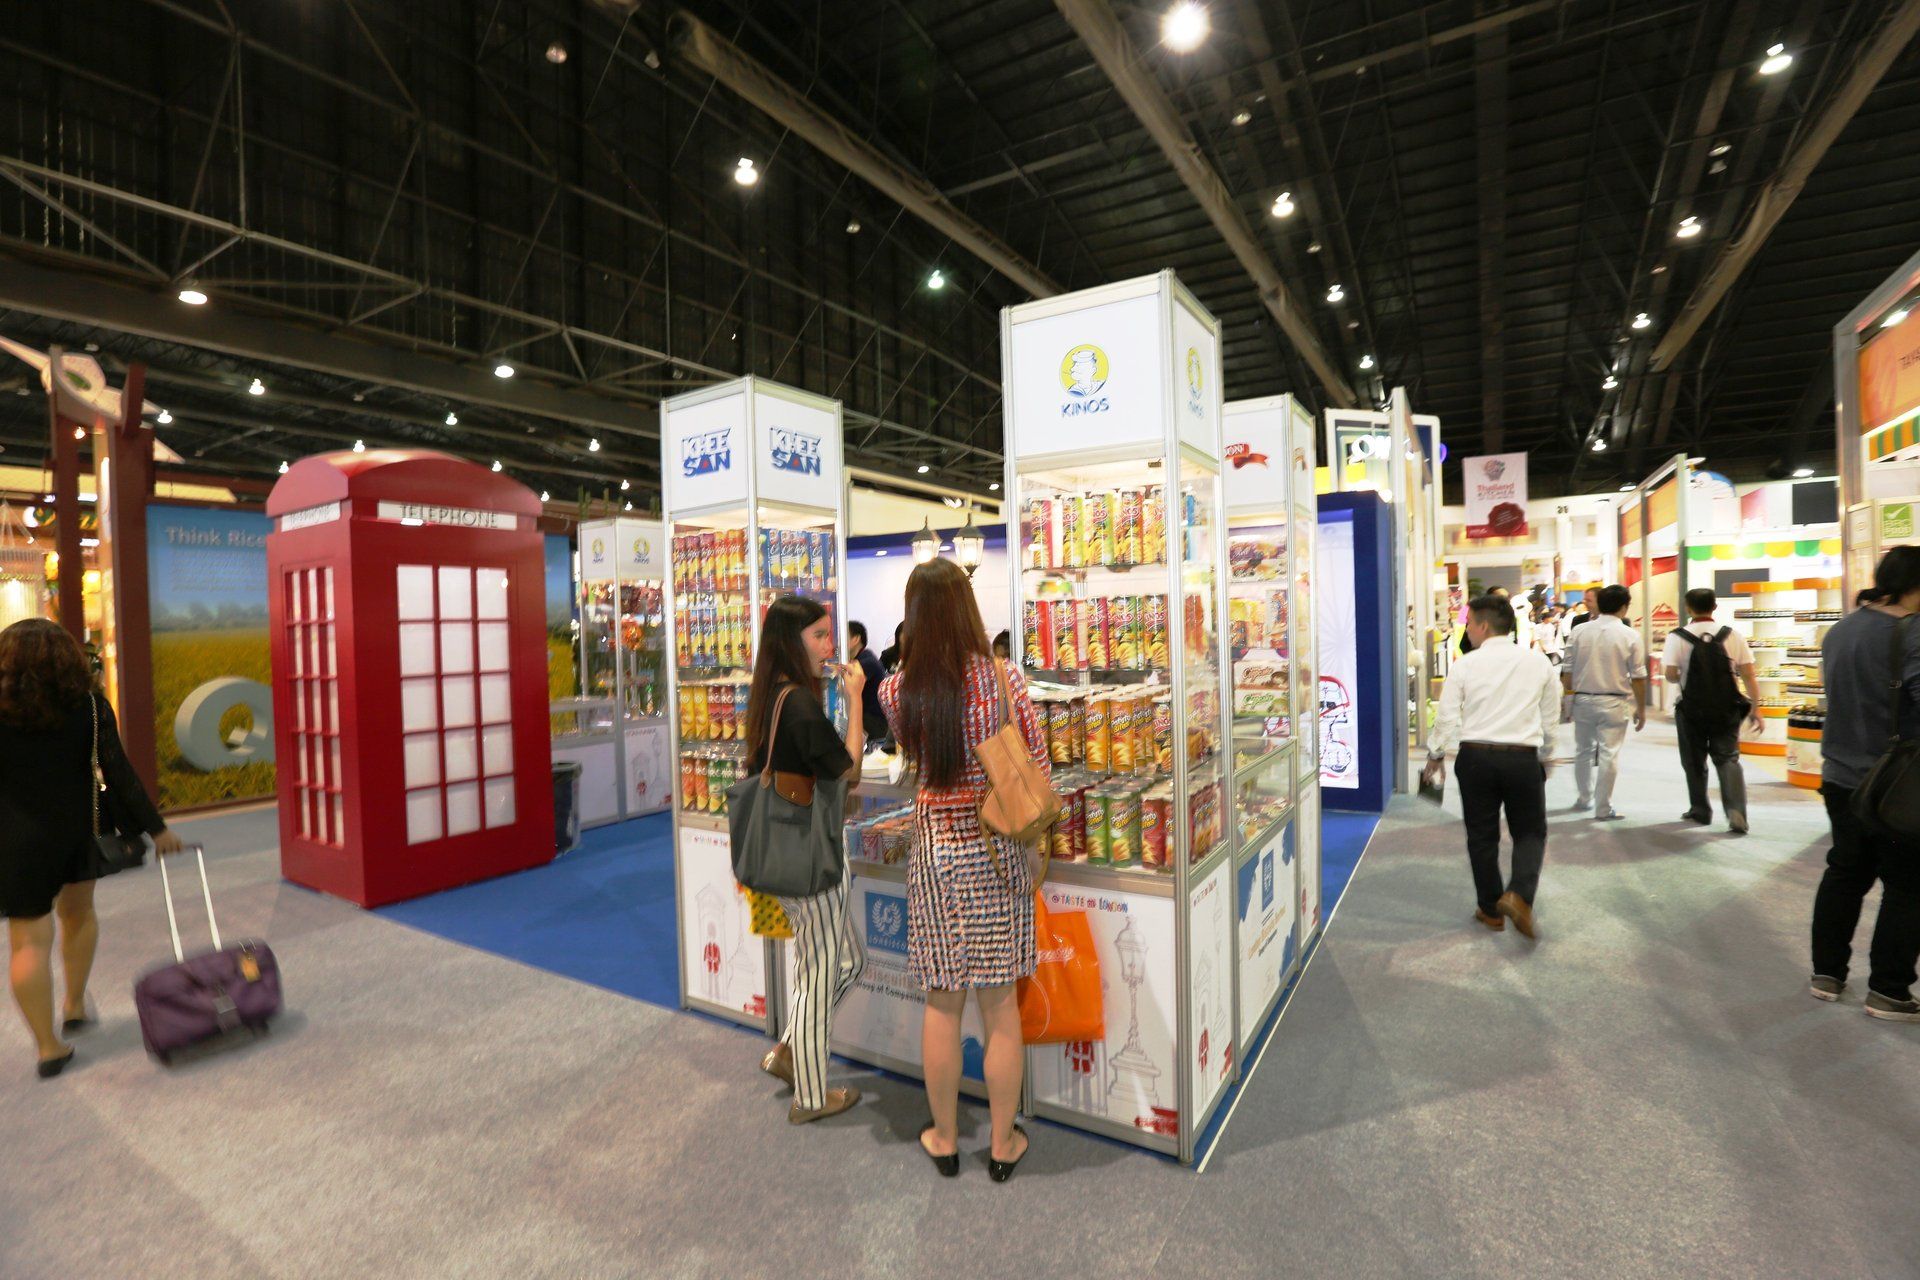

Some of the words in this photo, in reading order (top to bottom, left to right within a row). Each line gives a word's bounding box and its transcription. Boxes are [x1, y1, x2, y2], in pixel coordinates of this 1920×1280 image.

[1061, 397, 1110, 418] KINOS
[683, 449, 731, 478] SAN
[770, 449, 821, 477] SAN
[400, 504, 498, 529] TELEPHONE
[165, 526, 221, 546] Think
[228, 530, 266, 548] Rice
[1060, 895, 1086, 907] TASTE
